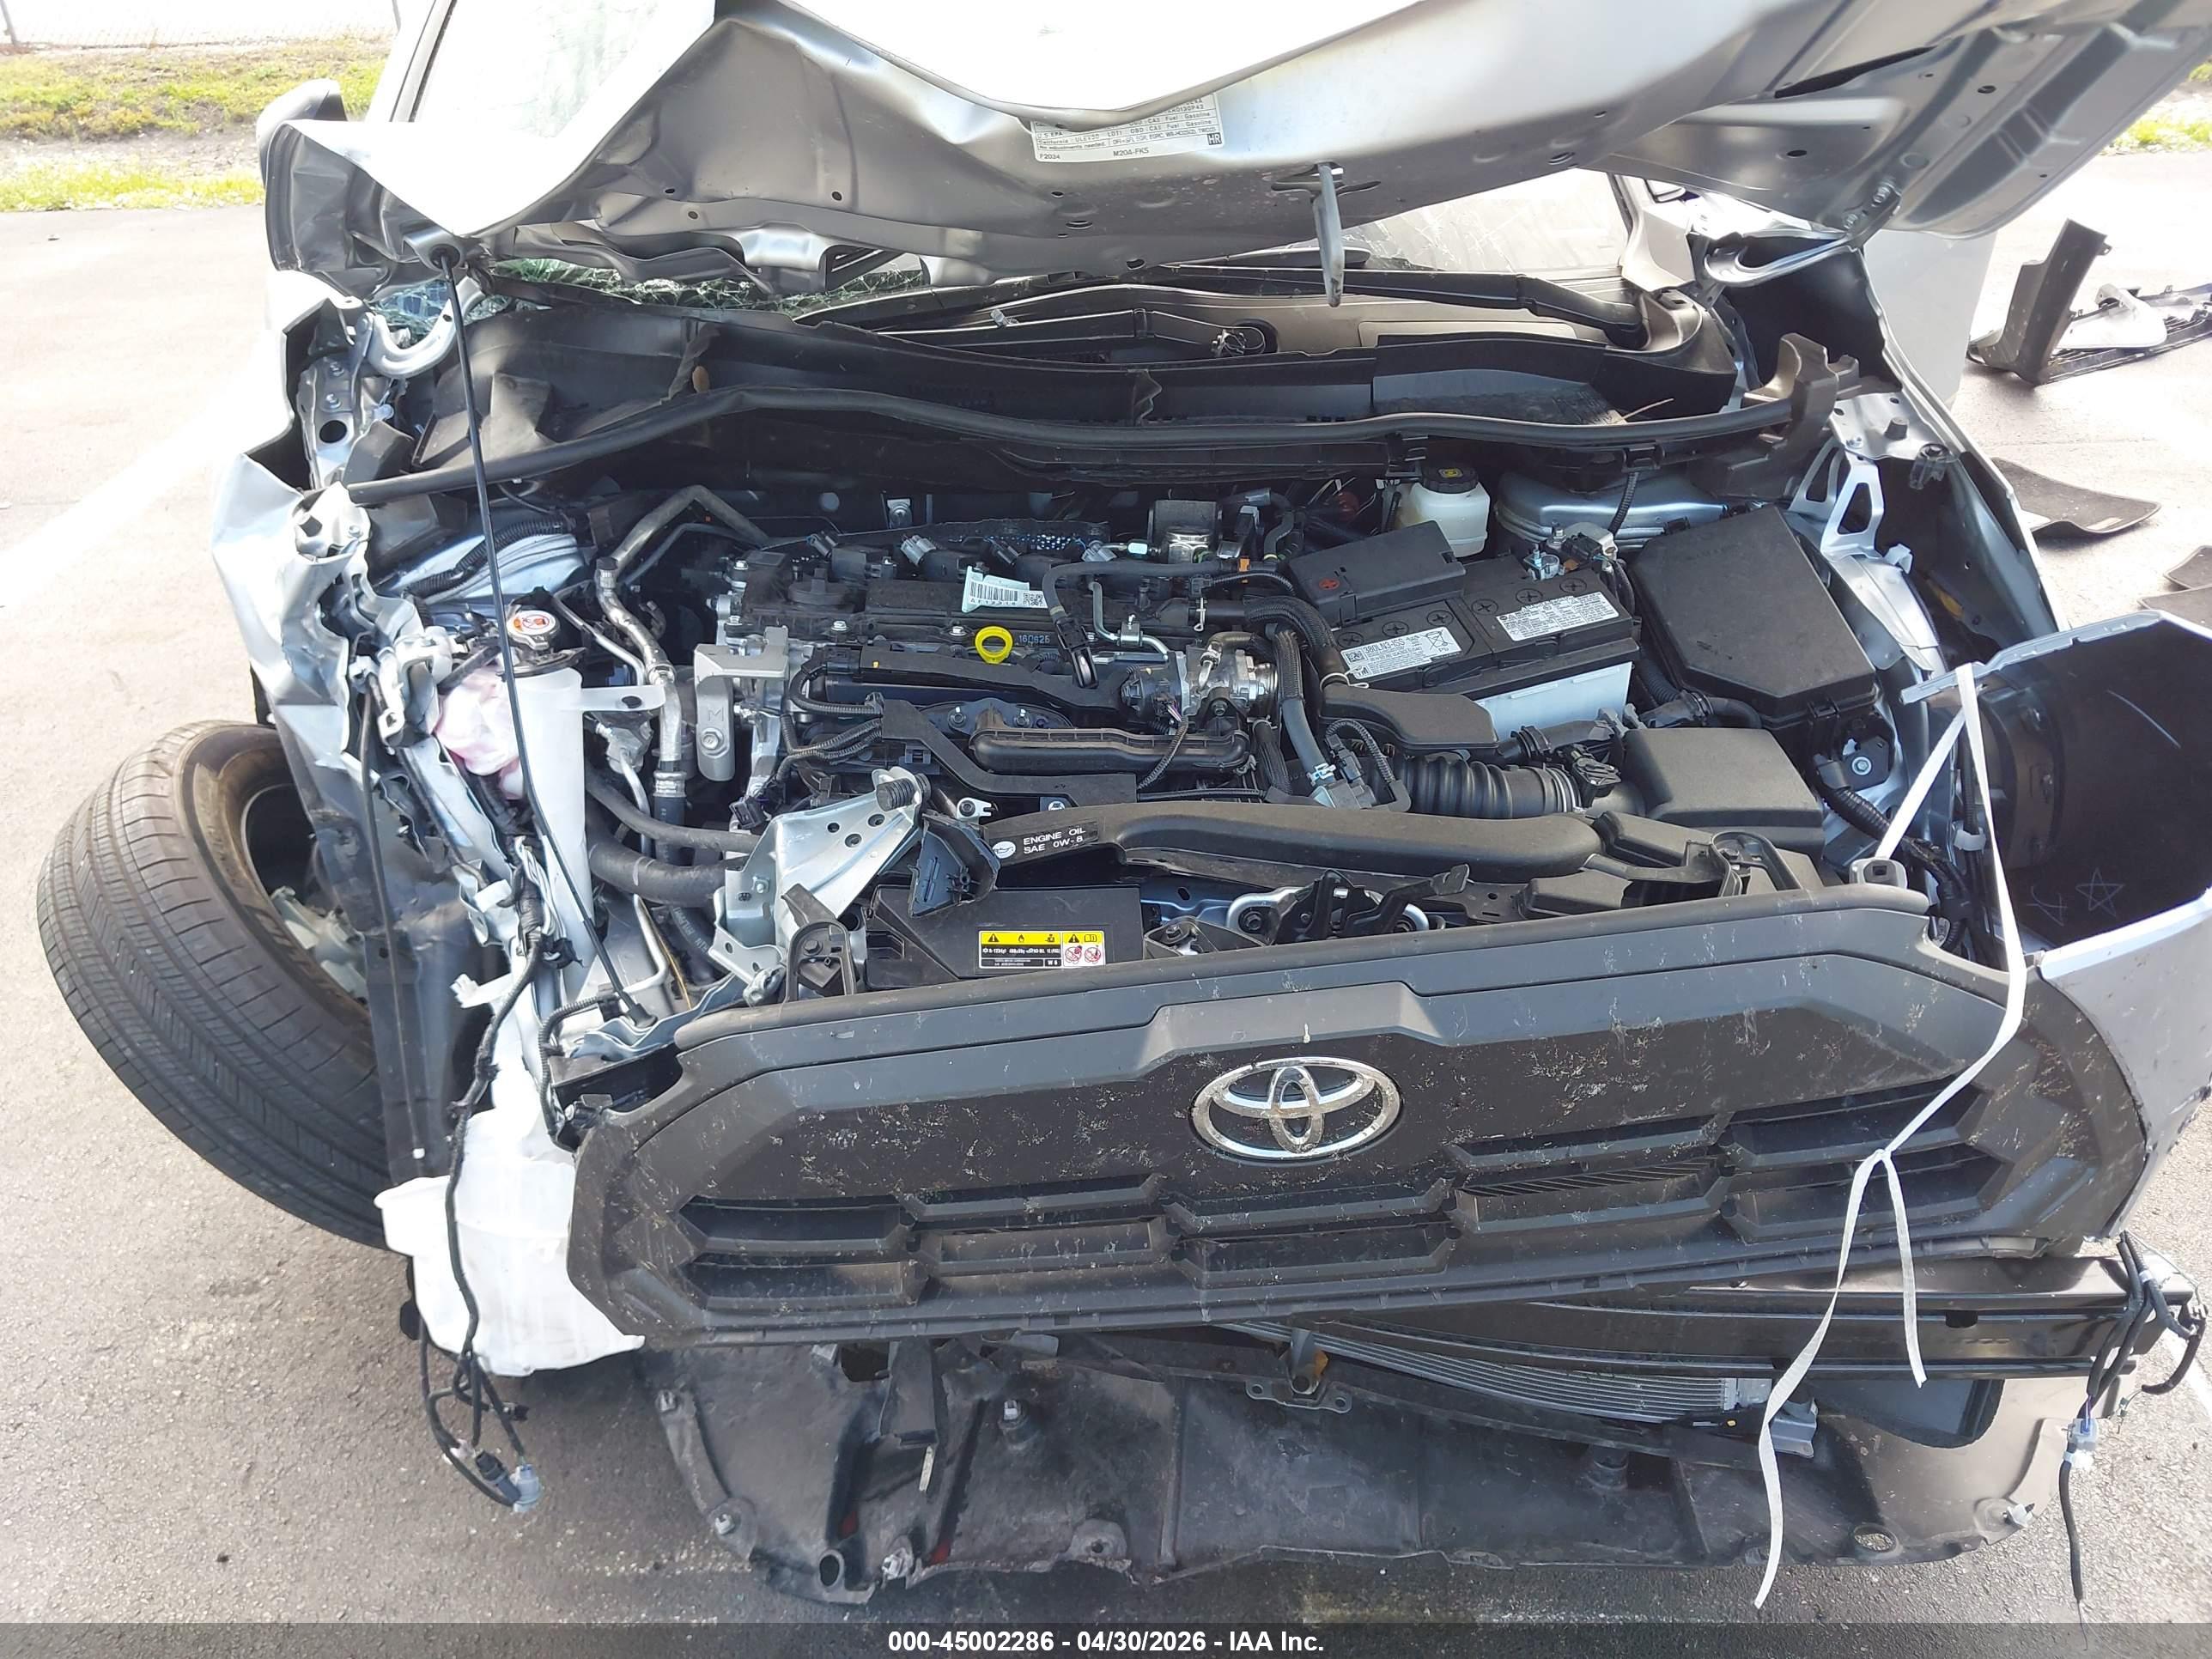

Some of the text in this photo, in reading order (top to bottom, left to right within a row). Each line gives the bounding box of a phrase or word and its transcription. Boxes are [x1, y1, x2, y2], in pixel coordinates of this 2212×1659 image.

[1208, 133, 1221, 145] HR
[1113, 147, 1149, 156] M20A-FKS
[1023, 827, 1086, 846] ENGINE OIL
[1024, 843, 1046, 854] SAE
